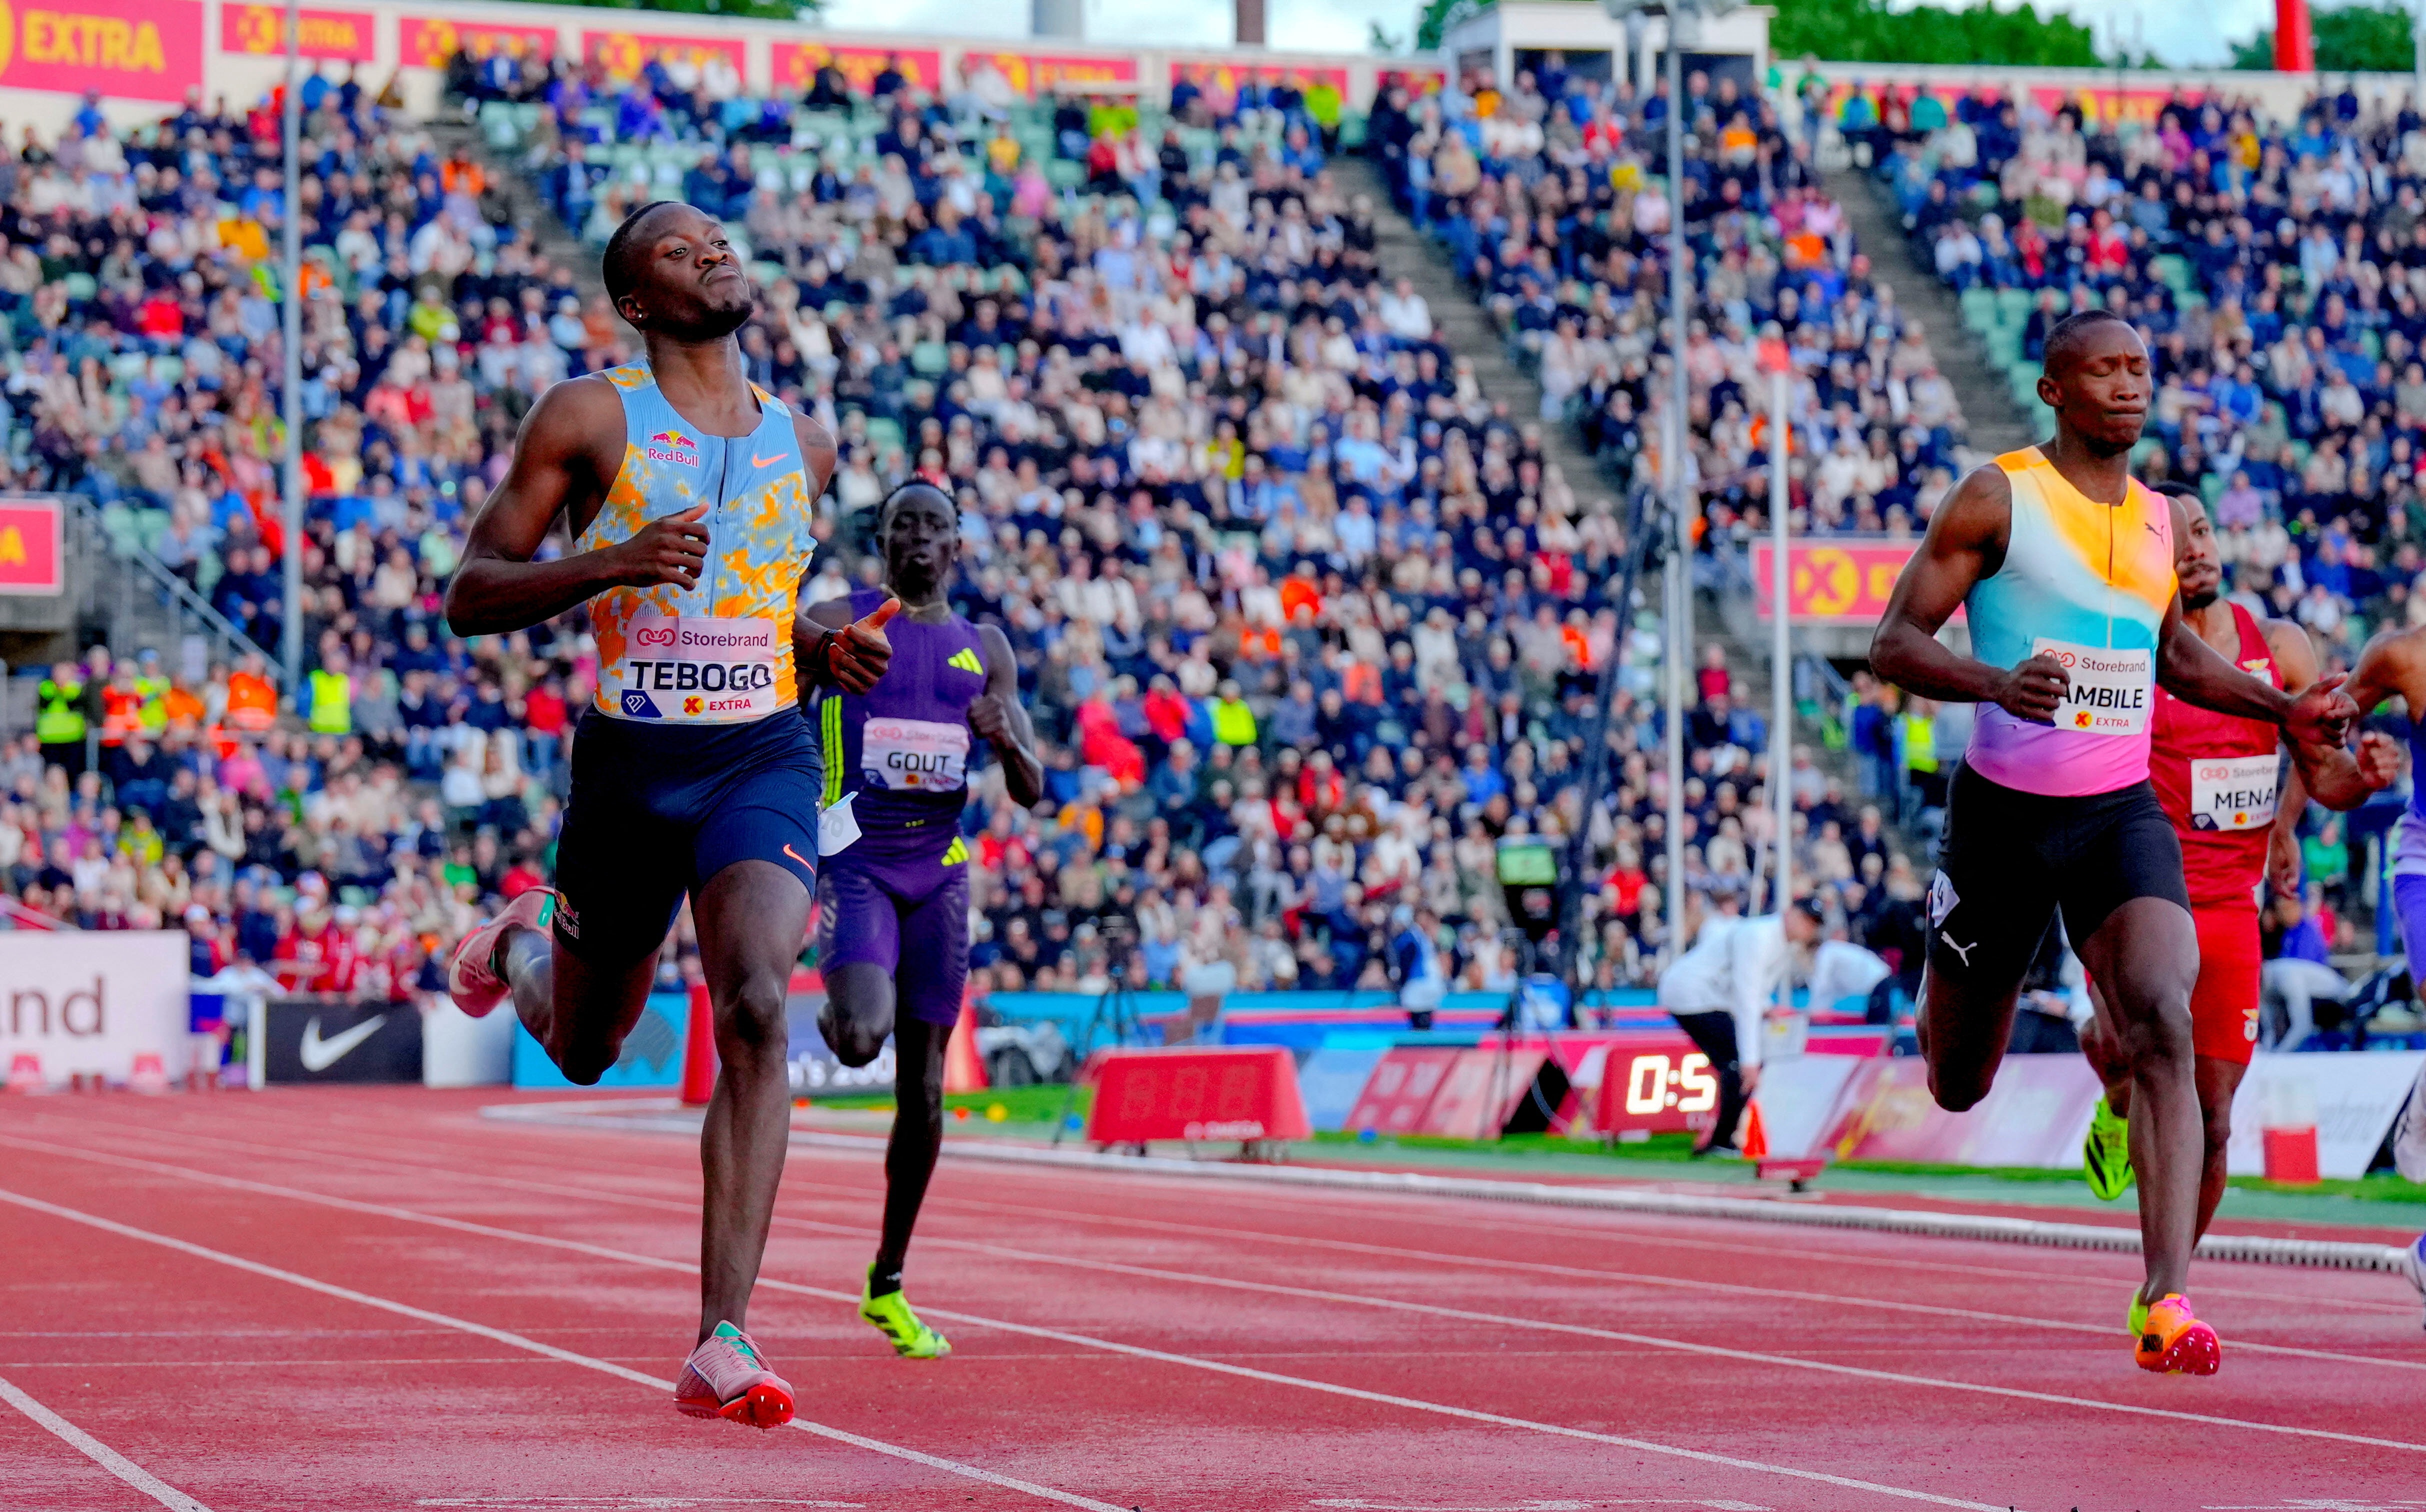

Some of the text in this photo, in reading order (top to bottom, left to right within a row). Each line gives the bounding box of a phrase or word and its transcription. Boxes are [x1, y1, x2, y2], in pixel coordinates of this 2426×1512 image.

[24, 9, 166, 72] EXTRA
[648, 448, 698, 468] Red Bull
[681, 631, 768, 646] Storebrand
[2081, 658, 2146, 672] Storebrand
[630, 661, 772, 692] TEBOGO
[709, 698, 752, 710] EXTRA
[2096, 717, 2130, 728] EXTRA
[888, 752, 950, 772] GOUT
[2215, 788, 2274, 810] MENA
[1626, 1052, 1717, 1114] 0:5
